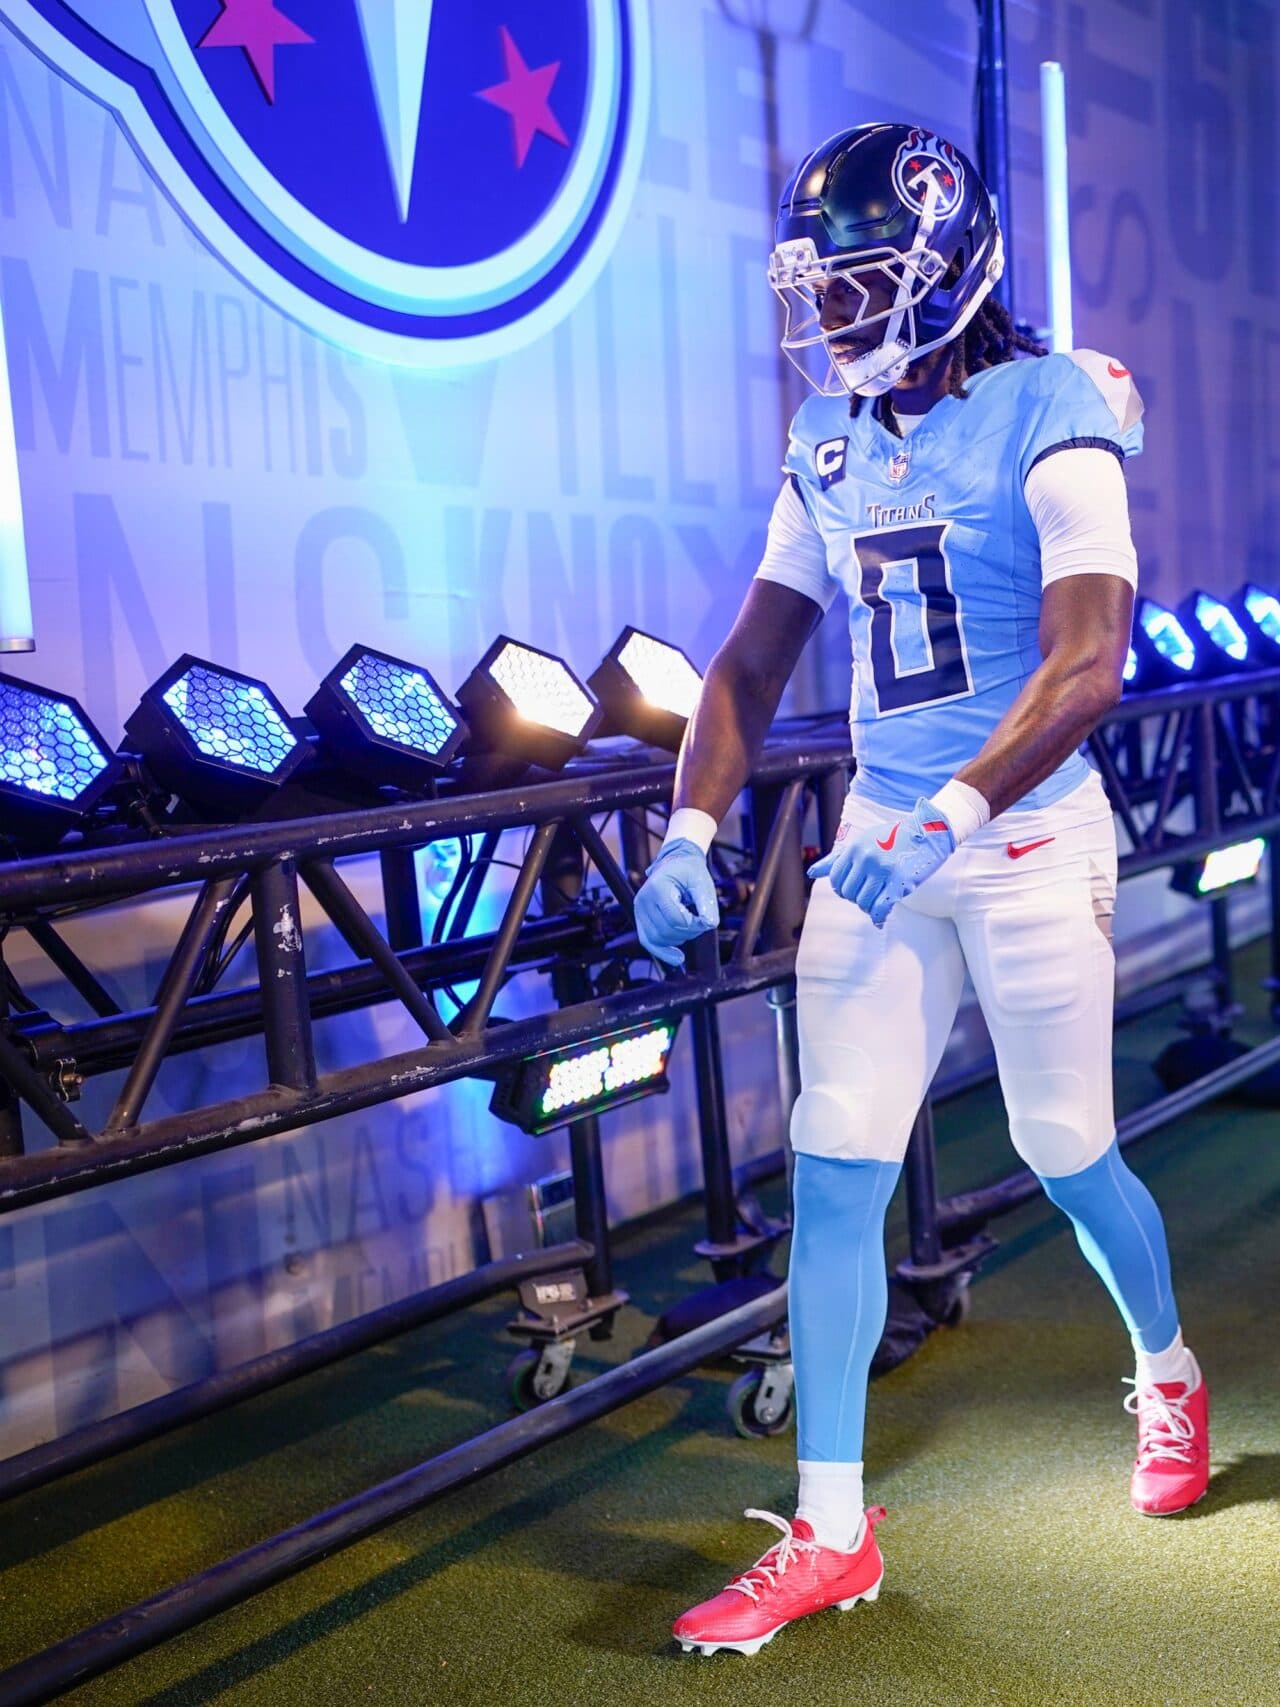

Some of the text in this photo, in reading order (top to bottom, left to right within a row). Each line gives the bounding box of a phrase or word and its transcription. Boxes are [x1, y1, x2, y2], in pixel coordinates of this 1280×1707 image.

[816, 439, 845, 477] C
[866, 493, 936, 529] TITANS
[851, 519, 975, 720] 0
